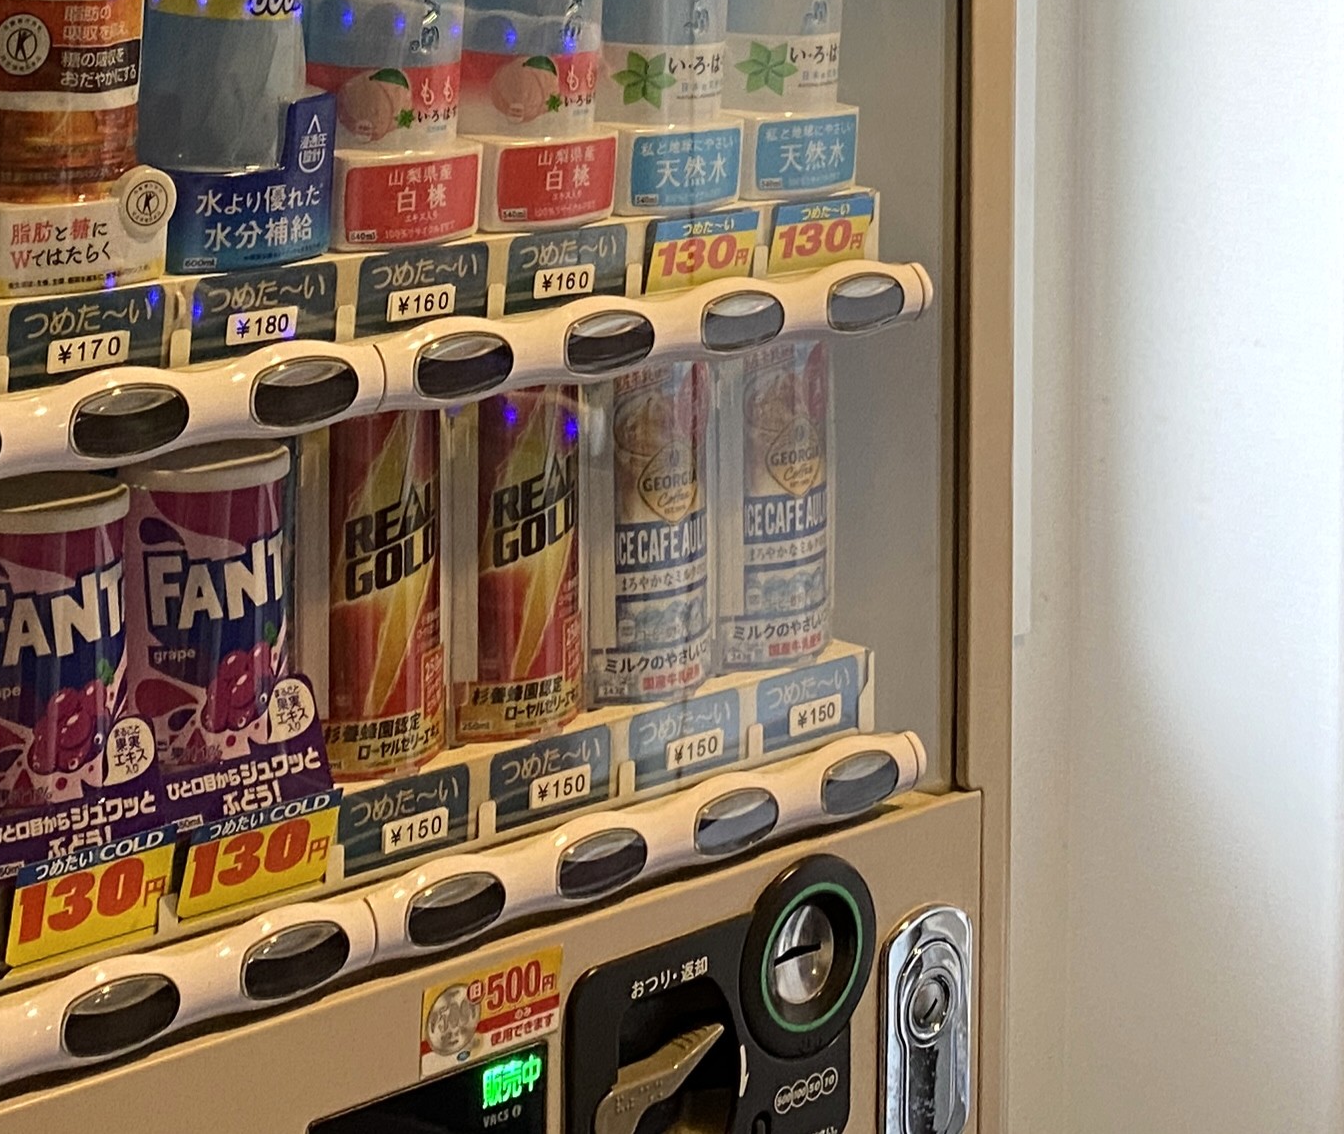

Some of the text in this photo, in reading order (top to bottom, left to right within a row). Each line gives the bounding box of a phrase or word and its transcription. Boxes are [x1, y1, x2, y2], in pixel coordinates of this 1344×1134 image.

[656, 154, 728, 189] 天然水
[778, 138, 846, 175] 天然水
[388, 163, 454, 188] 山梨県産
[197, 181, 321, 218] 水より優れた
[397, 184, 448, 214] 白桃
[10, 217, 108, 247] 脂肪と糖に
[205, 215, 314, 253] 水分補給
[778, 217, 864, 259] 130円
[658, 234, 750, 277] 130円
[542, 270, 590, 293] ¥160
[398, 290, 449, 316] ¥160
[236, 313, 290, 339] ¥180
[58, 336, 122, 365] ¥170
[344, 473, 436, 559] REAL
[344, 517, 437, 601] GOLD
[637, 527, 681, 565] CAFE
[674, 735, 718, 766] ¥150
[538, 772, 587, 803] ¥150
[269, 793, 330, 822] COLD
[99, 831, 164, 861] COLD
[390, 815, 443, 848] ¥150
[189, 818, 331, 899] 130円
[486, 959, 555, 1012] 500円
[490, 1011, 554, 1047] 使用できます
[482, 1052, 543, 1110] 販売中
